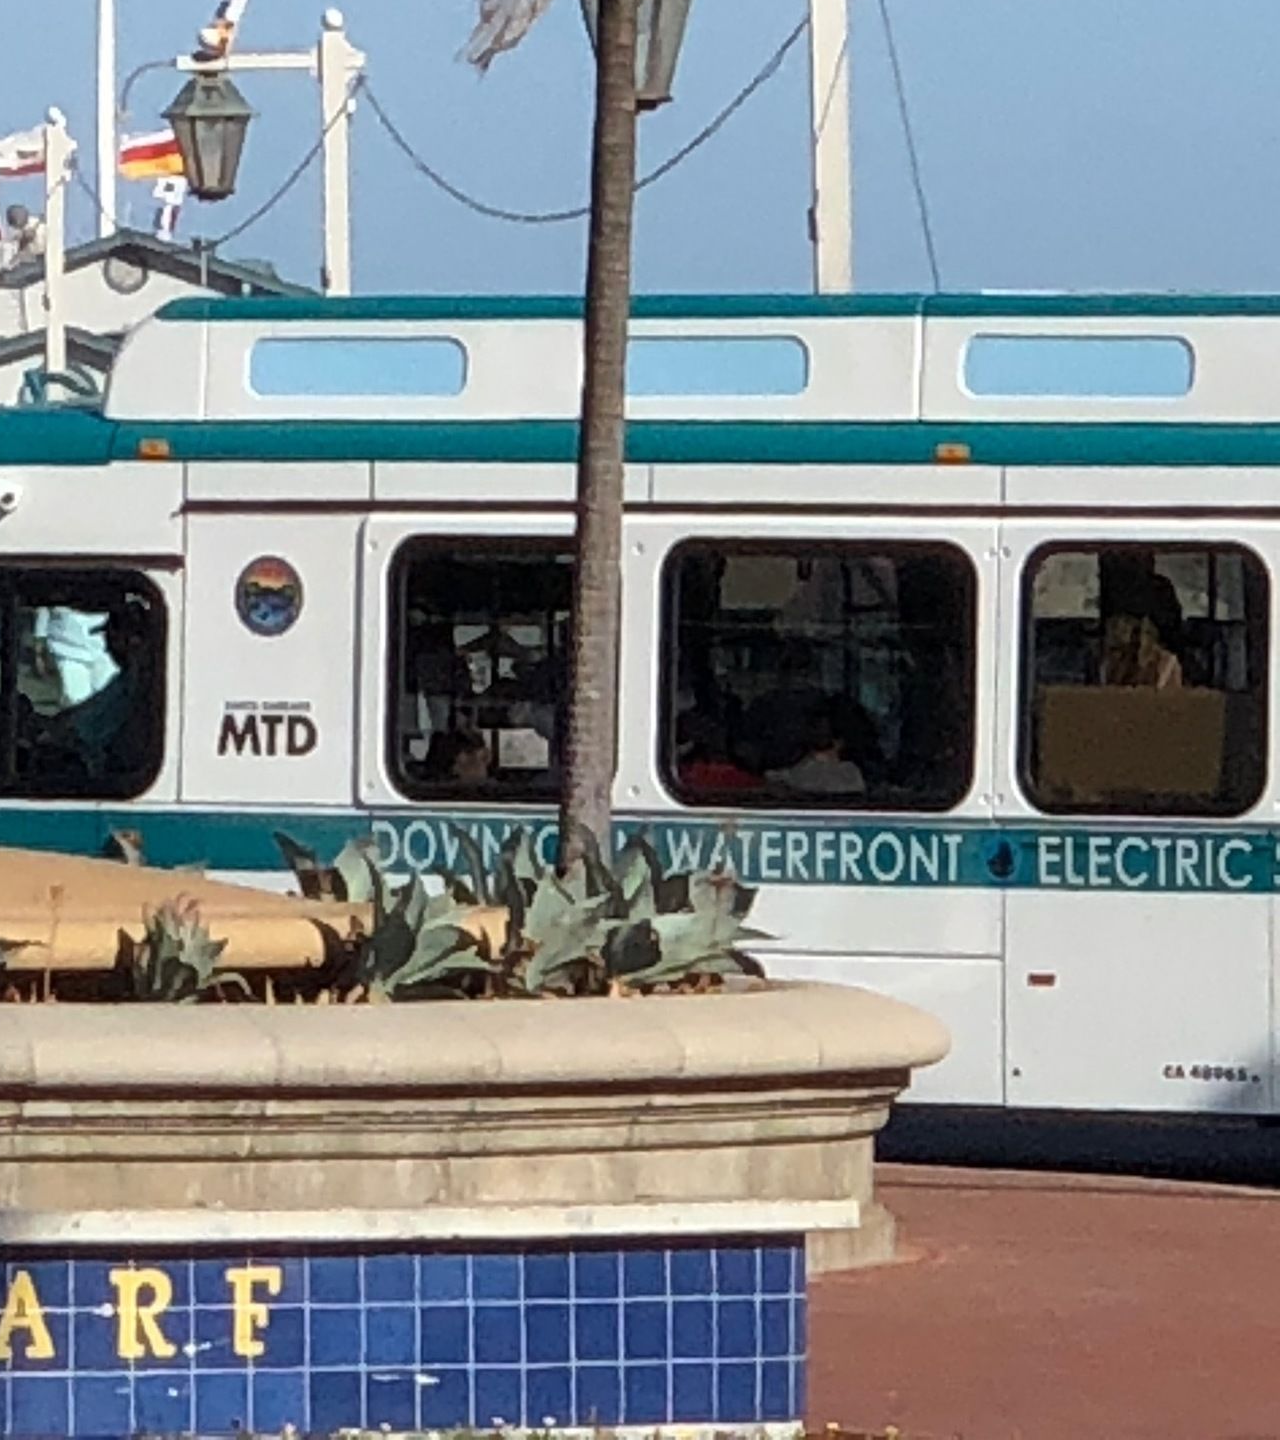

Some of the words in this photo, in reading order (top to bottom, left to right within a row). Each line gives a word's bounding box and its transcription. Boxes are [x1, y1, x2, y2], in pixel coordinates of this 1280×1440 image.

[217, 714, 318, 756] MTD
[371, 820, 626, 871] DOWNO
[664, 828, 963, 882] WATERFRONT
[1036, 836, 1253, 888] ELECTRIC
